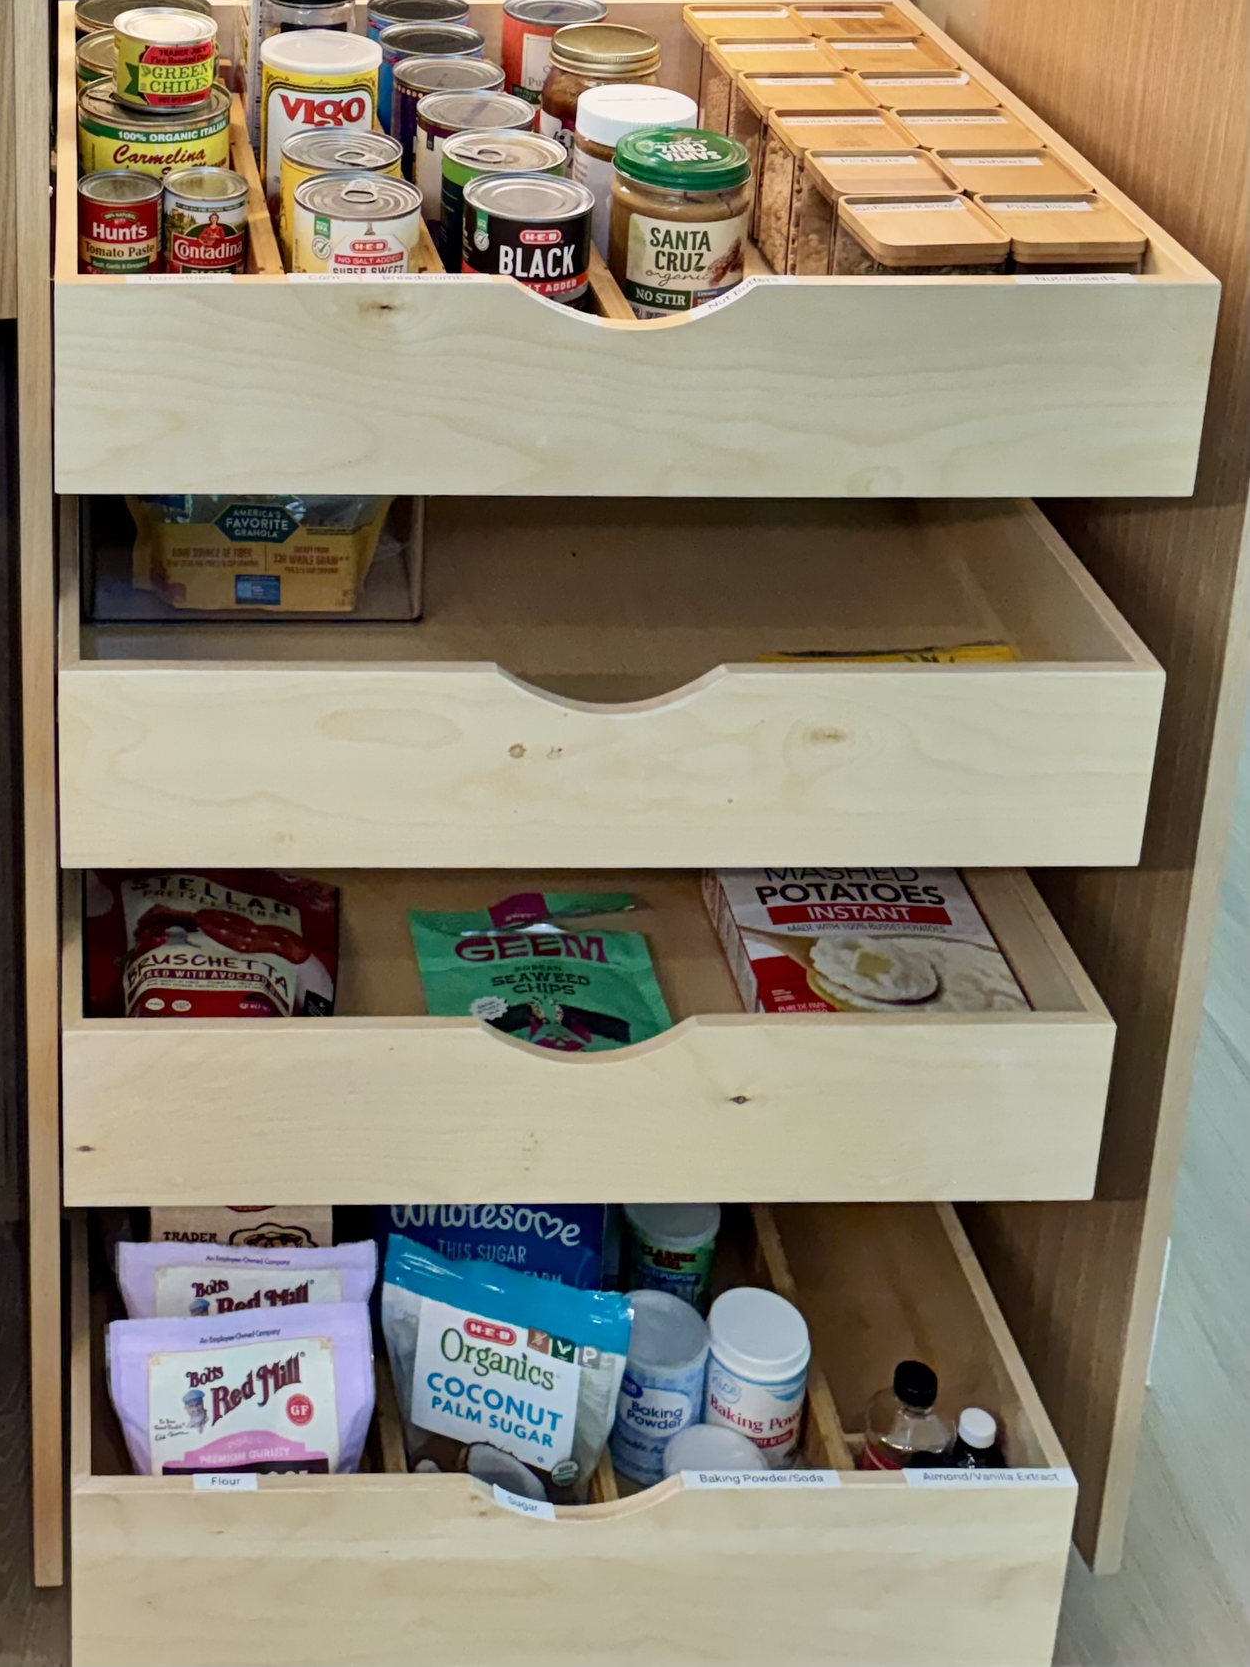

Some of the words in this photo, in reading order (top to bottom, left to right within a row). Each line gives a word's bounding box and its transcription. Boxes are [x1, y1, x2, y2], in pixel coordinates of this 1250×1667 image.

[152, 62, 209, 80] GREEN
[118, 130, 147, 142] 100%
[150, 128, 198, 143] ORGANIC
[200, 120, 228, 139] ITALIAN
[113, 144, 207, 165] Carmelina
[655, 150, 722, 163] SANTA
[656, 142, 708, 155] CRUZ
[967, 157, 1026, 165] Cashews
[853, 201, 915, 211] Sunflower
[916, 200, 963, 210] Kernels
[1006, 201, 1073, 211] Pistachios
[92, 221, 148, 241] Hunt's
[649, 227, 712, 252] SANTA
[85, 241, 125, 258] Tomato
[128, 243, 155, 258] Paste
[174, 239, 243, 260] Contadina
[352, 256, 374, 264] SALT
[375, 255, 402, 264] ADDED
[499, 244, 576, 277] BLACK
[654, 251, 706, 273] CRUZ
[545, 279, 578, 292] ADDED
[1034, 273, 1118, 283] Nuts/Seeds
[636, 288, 653, 301] NO
[655, 291, 686, 307] STIR
[707, 295, 730, 310] Nut
[232, 508, 282, 519] AMERICA'S
[225, 517, 289, 531] FAVORITE
[234, 528, 278, 539] GRANOLA
[233, 548, 253, 558] FIBER
[288, 554, 314, 565] WHOLE
[766, 867, 919, 882] MASHED
[130, 877, 292, 917] STELLAR
[755, 883, 946, 905] POTATOES
[807, 905, 911, 921] INSTANT
[787, 922, 815, 932] MADE
[816, 922, 840, 932] WITH
[455, 935, 610, 964] GEEM
[127, 952, 289, 999] BRUSCHETTA
[174, 969, 206, 980] WITH
[210, 970, 268, 985] AVOCADO
[491, 971, 591, 986] SEAWEED
[512, 983, 577, 996] CHIPS
[162, 1230, 218, 1244] TRADER
[437, 1239, 472, 1261] THIS
[478, 1243, 527, 1265] SUGAR
[264, 1258, 291, 1266] Company
[191, 1279, 229, 1298] Bob's
[216, 1290, 262, 1314] Red
[264, 1280, 310, 1309] Mill
[255, 1328, 282, 1339] Company
[440, 1328, 555, 1391] Organics
[186, 1365, 224, 1389] Bob's
[210, 1369, 256, 1427] Red
[256, 1351, 303, 1407] Mill
[426, 1371, 564, 1432] COCONUT
[631, 1399, 684, 1419] Baking
[290, 1404, 310, 1417] GF
[709, 1395, 763, 1433] Baking
[431, 1396, 482, 1424] PALM
[488, 1414, 554, 1449] SUGAR
[626, 1409, 684, 1430] Powder
[199, 1452, 247, 1464] PREMIUM
[248, 1446, 291, 1460] QUALITY
[211, 1475, 242, 1486] Flour
[699, 1473, 741, 1485] Baking
[743, 1473, 825, 1483] Powder/Soda
[922, 1470, 1015, 1482] Almond/Vanilla
[1016, 1471, 1060, 1482] Extract
[507, 1495, 538, 1513] Sugar
